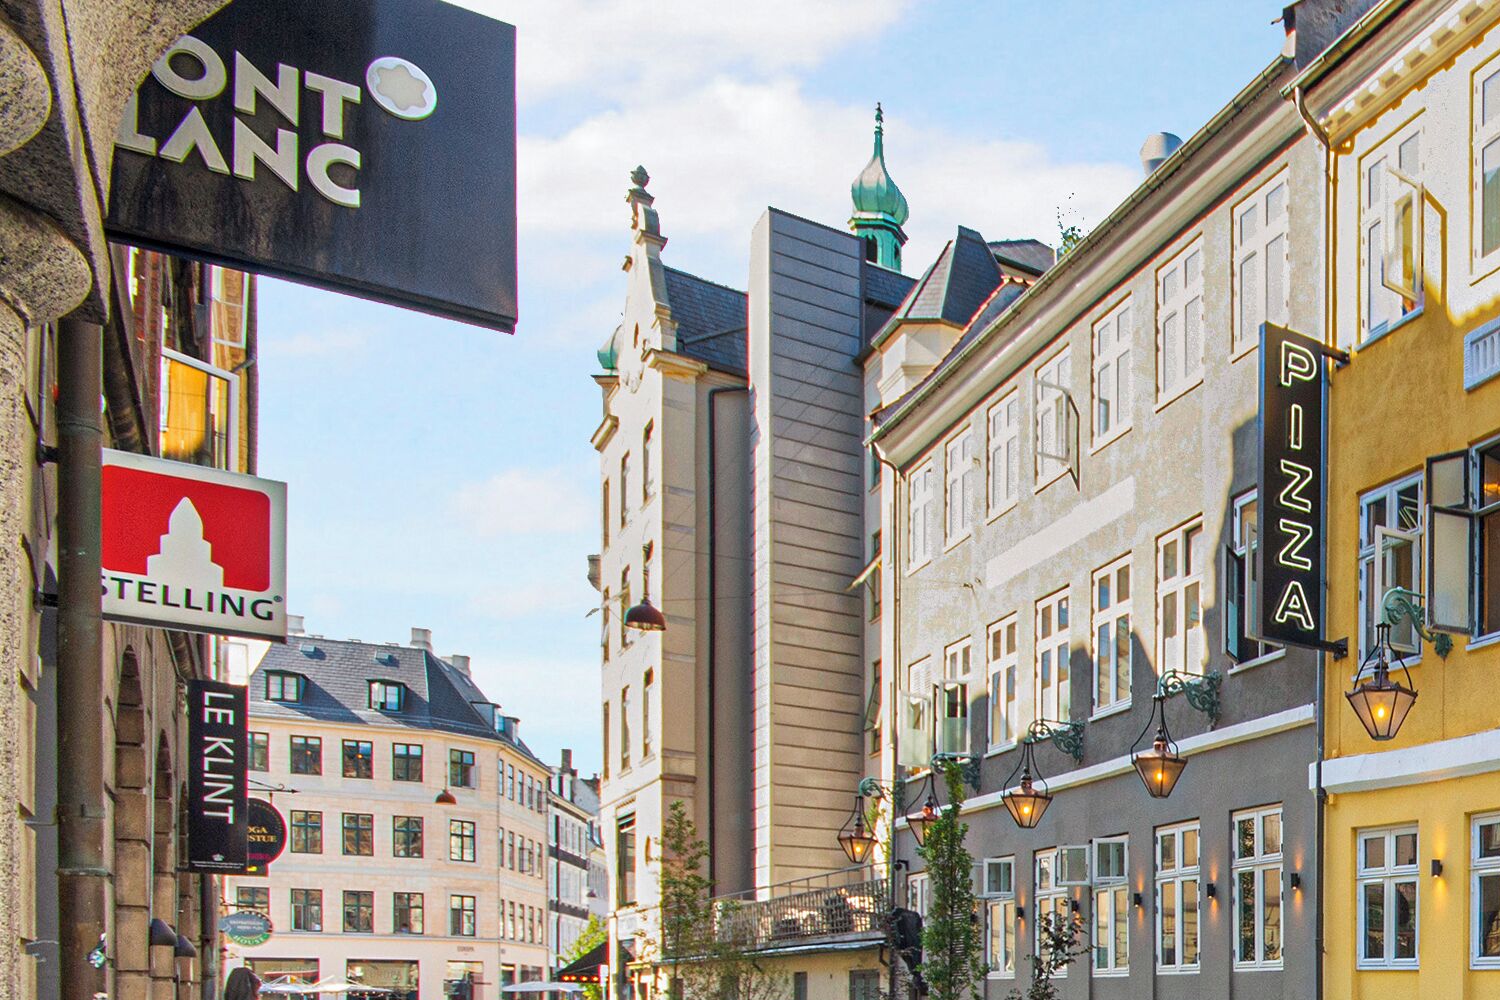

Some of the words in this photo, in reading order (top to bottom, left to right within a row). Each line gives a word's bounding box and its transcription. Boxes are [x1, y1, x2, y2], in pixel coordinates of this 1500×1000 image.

[151, 35, 361, 139] ONT
[114, 91, 361, 208] LANC
[1275, 340, 1318, 631] PIZZA
[203, 691, 234, 725] LE
[203, 736, 234, 825] KLINT
